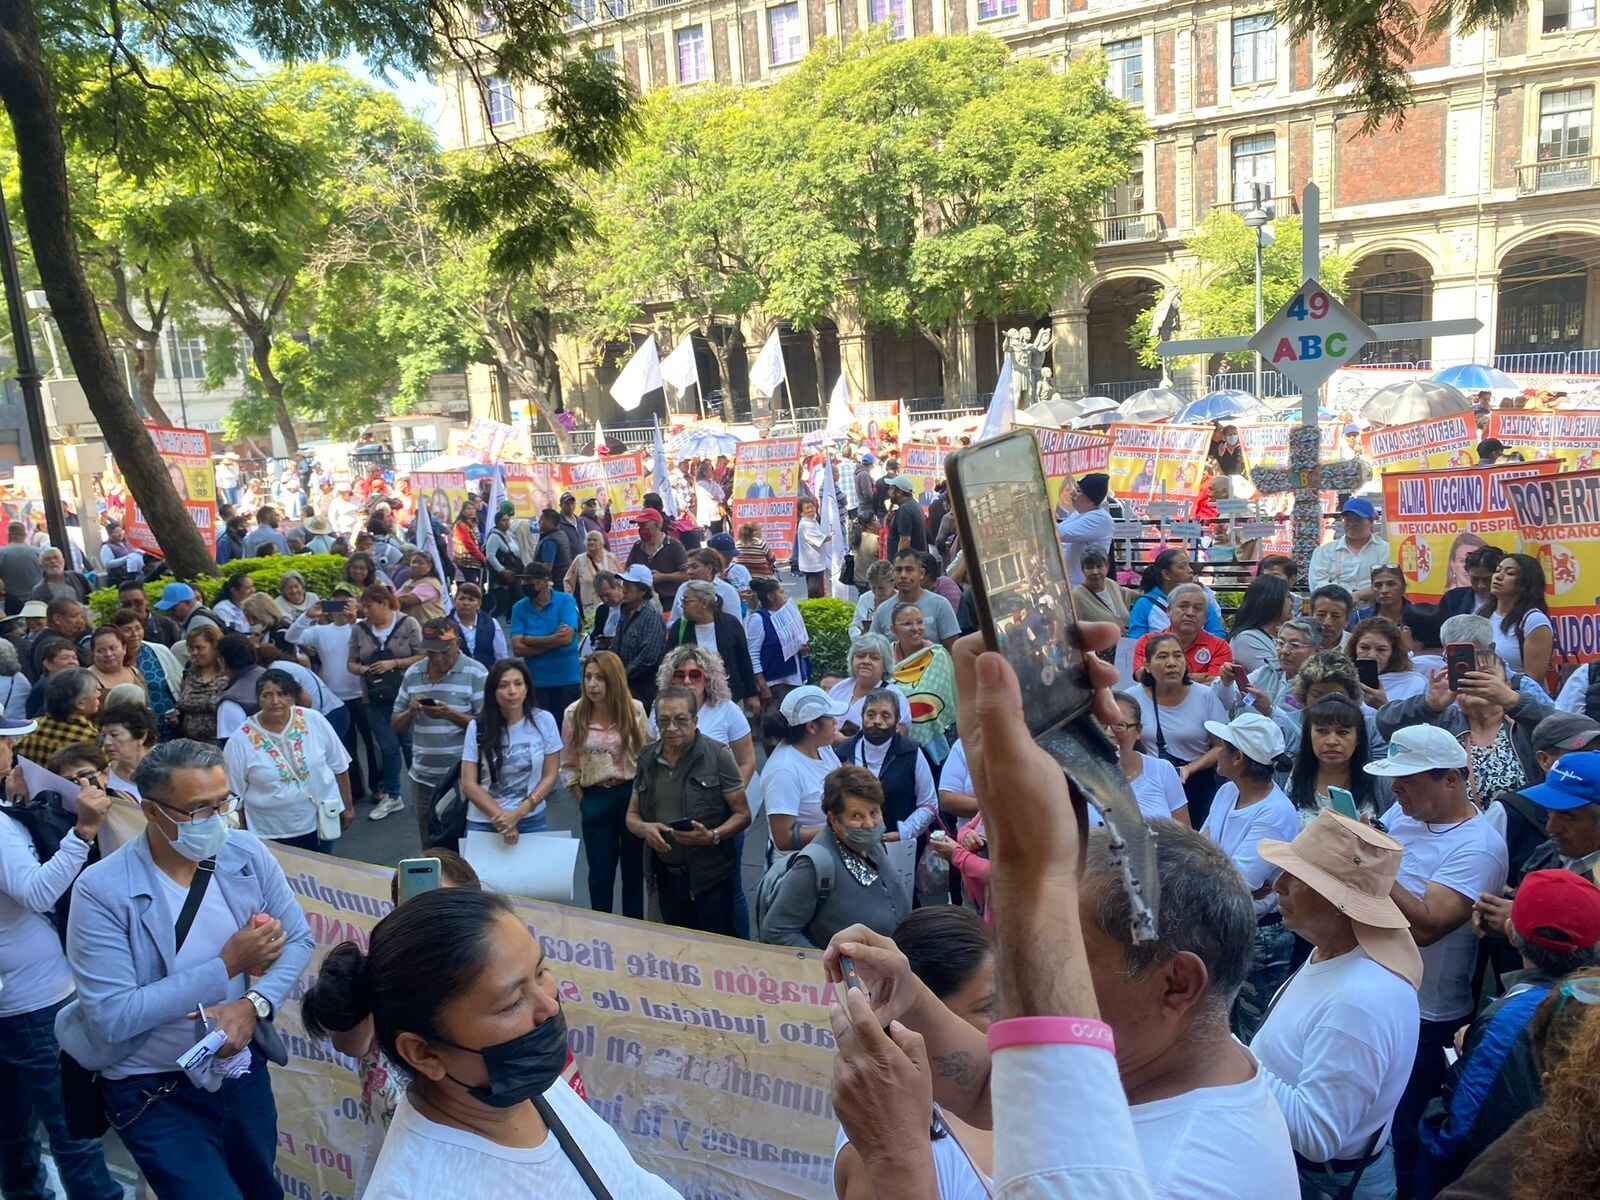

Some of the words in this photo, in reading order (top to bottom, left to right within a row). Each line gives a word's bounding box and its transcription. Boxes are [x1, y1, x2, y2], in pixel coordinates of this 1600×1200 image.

[1286, 291, 1330, 321] 49
[1272, 332, 1348, 363] ABC
[1400, 480, 1426, 514] ALMA
[1430, 476, 1483, 514] VIGGIANO
[1509, 478, 1600, 527] ROBERT
[1522, 526, 1600, 541] MEXICANO
